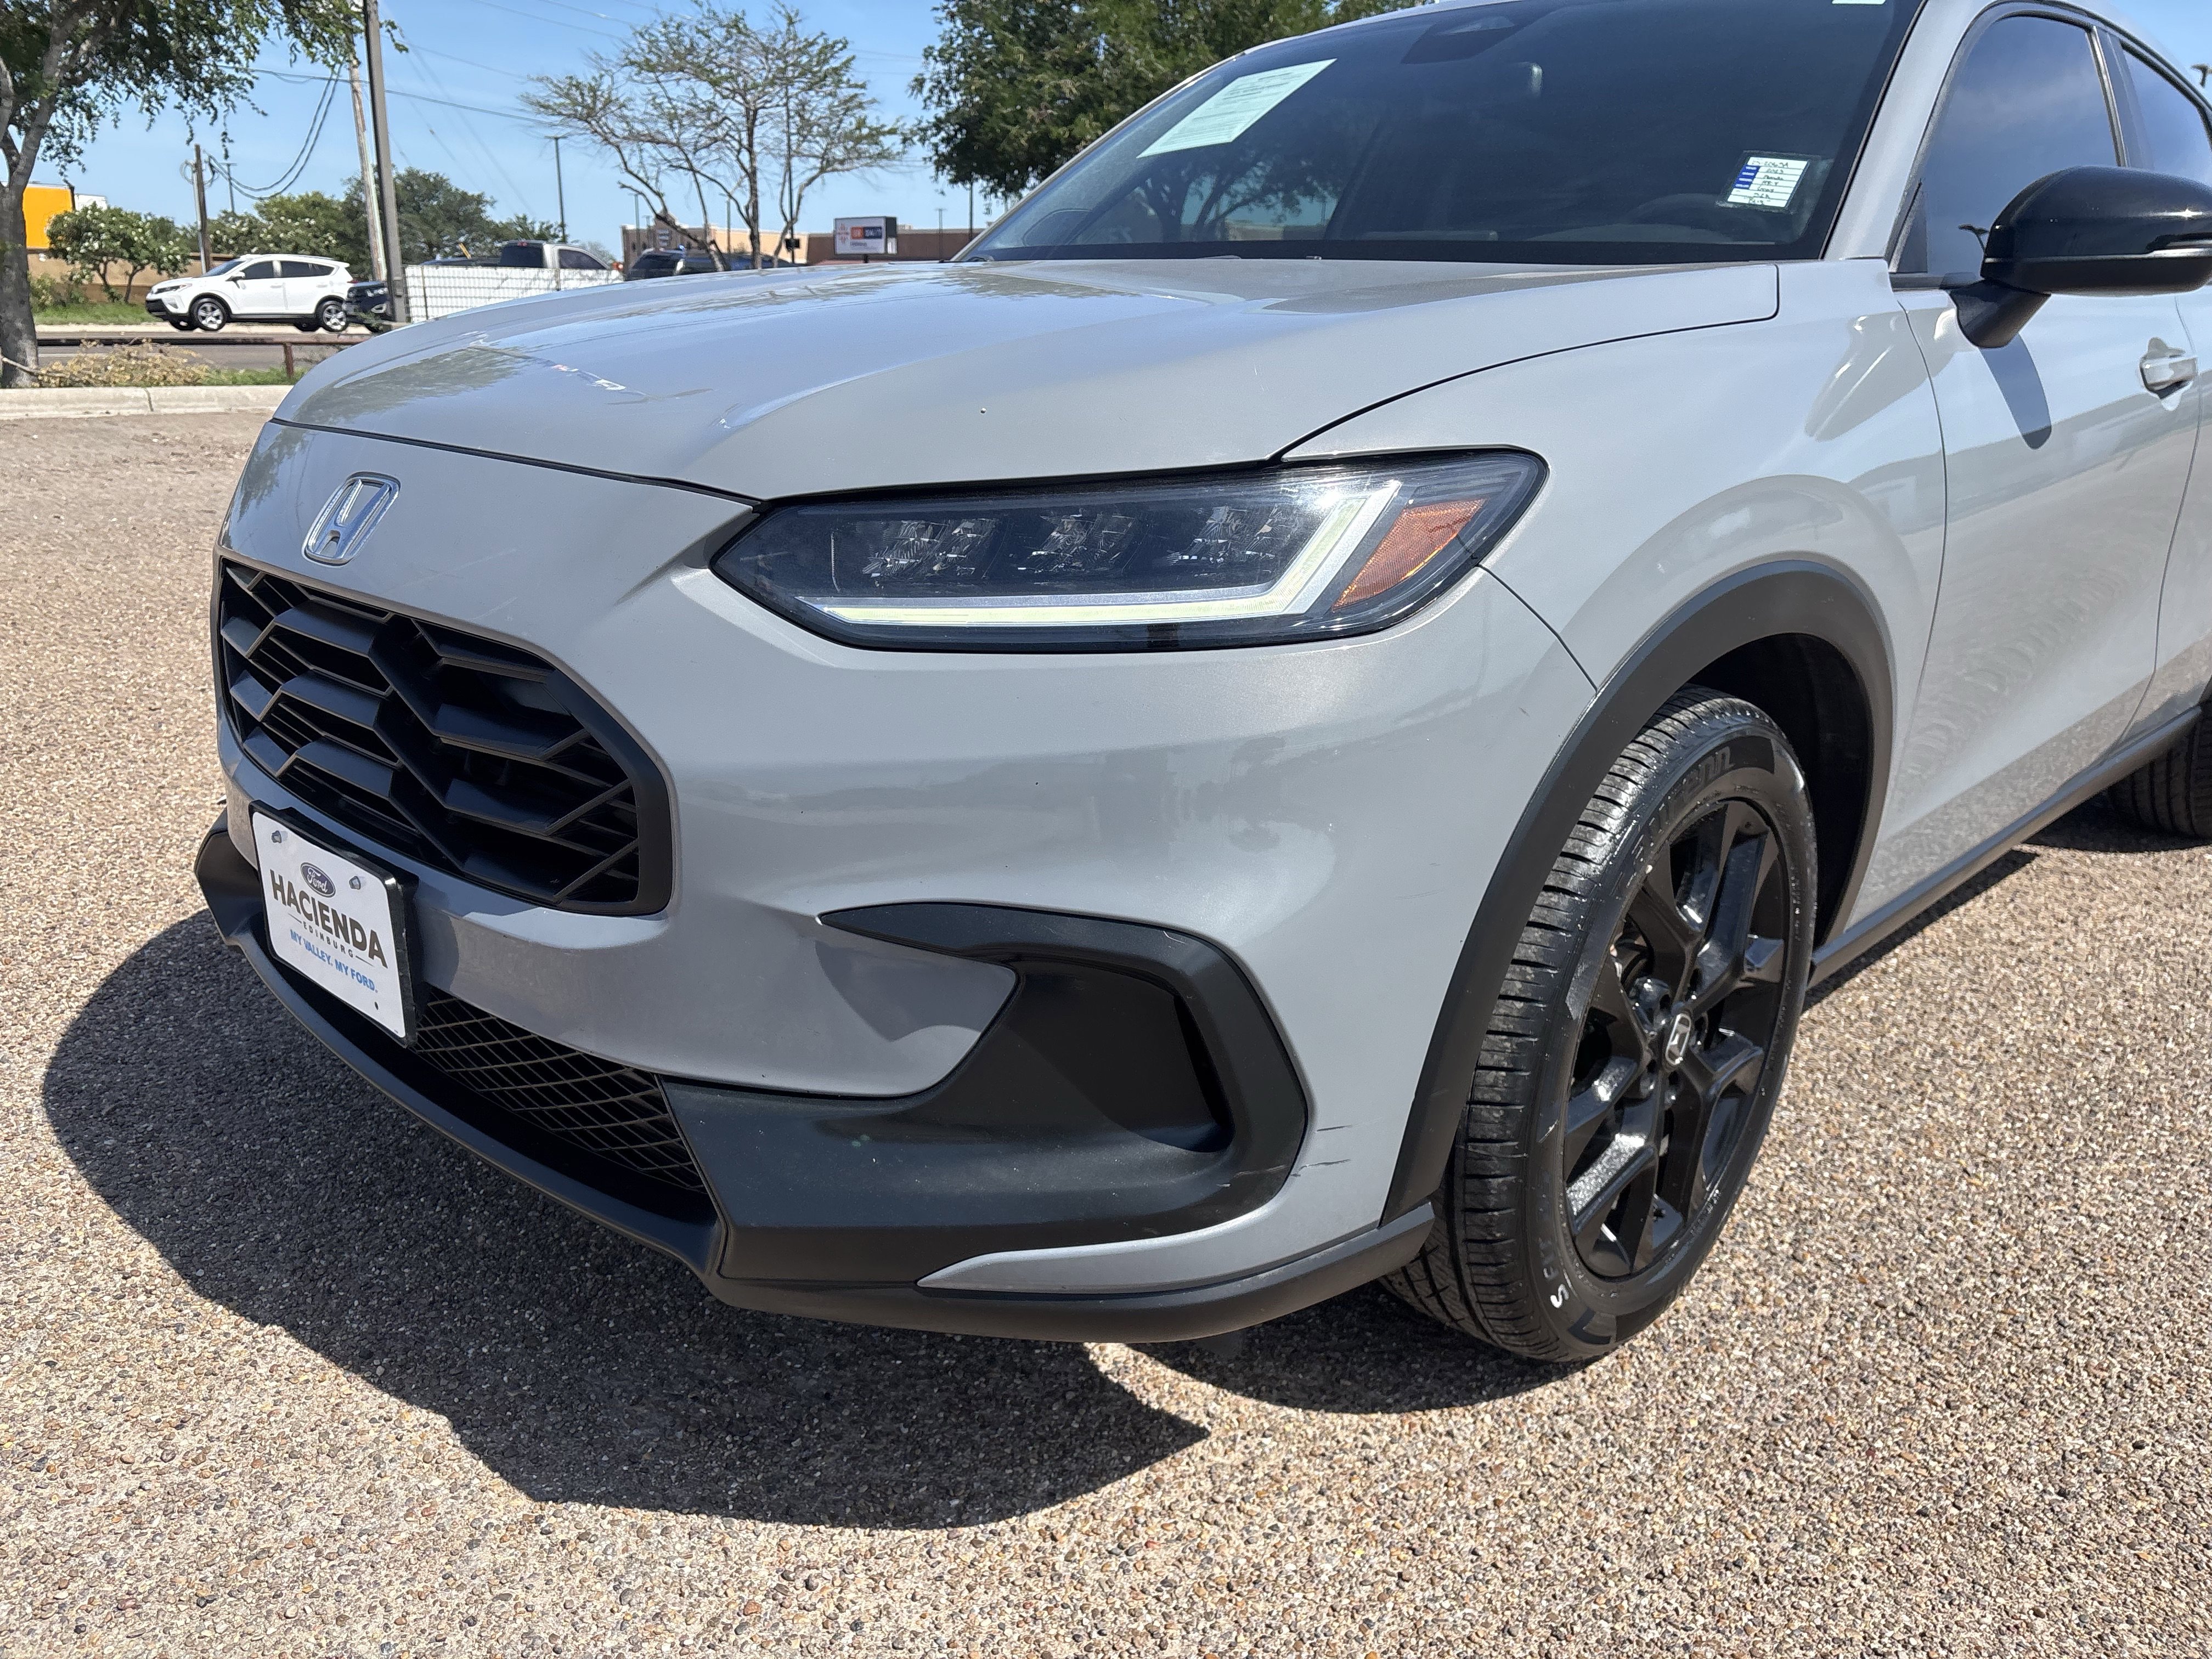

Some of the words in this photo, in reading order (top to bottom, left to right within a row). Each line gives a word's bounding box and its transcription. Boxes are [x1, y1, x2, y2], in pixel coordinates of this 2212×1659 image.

[270, 869, 388, 969] HACIENDA
[303, 921, 354, 958] EDINBURG
[290, 929, 302, 945] MY
[335, 959, 348, 975] MY
